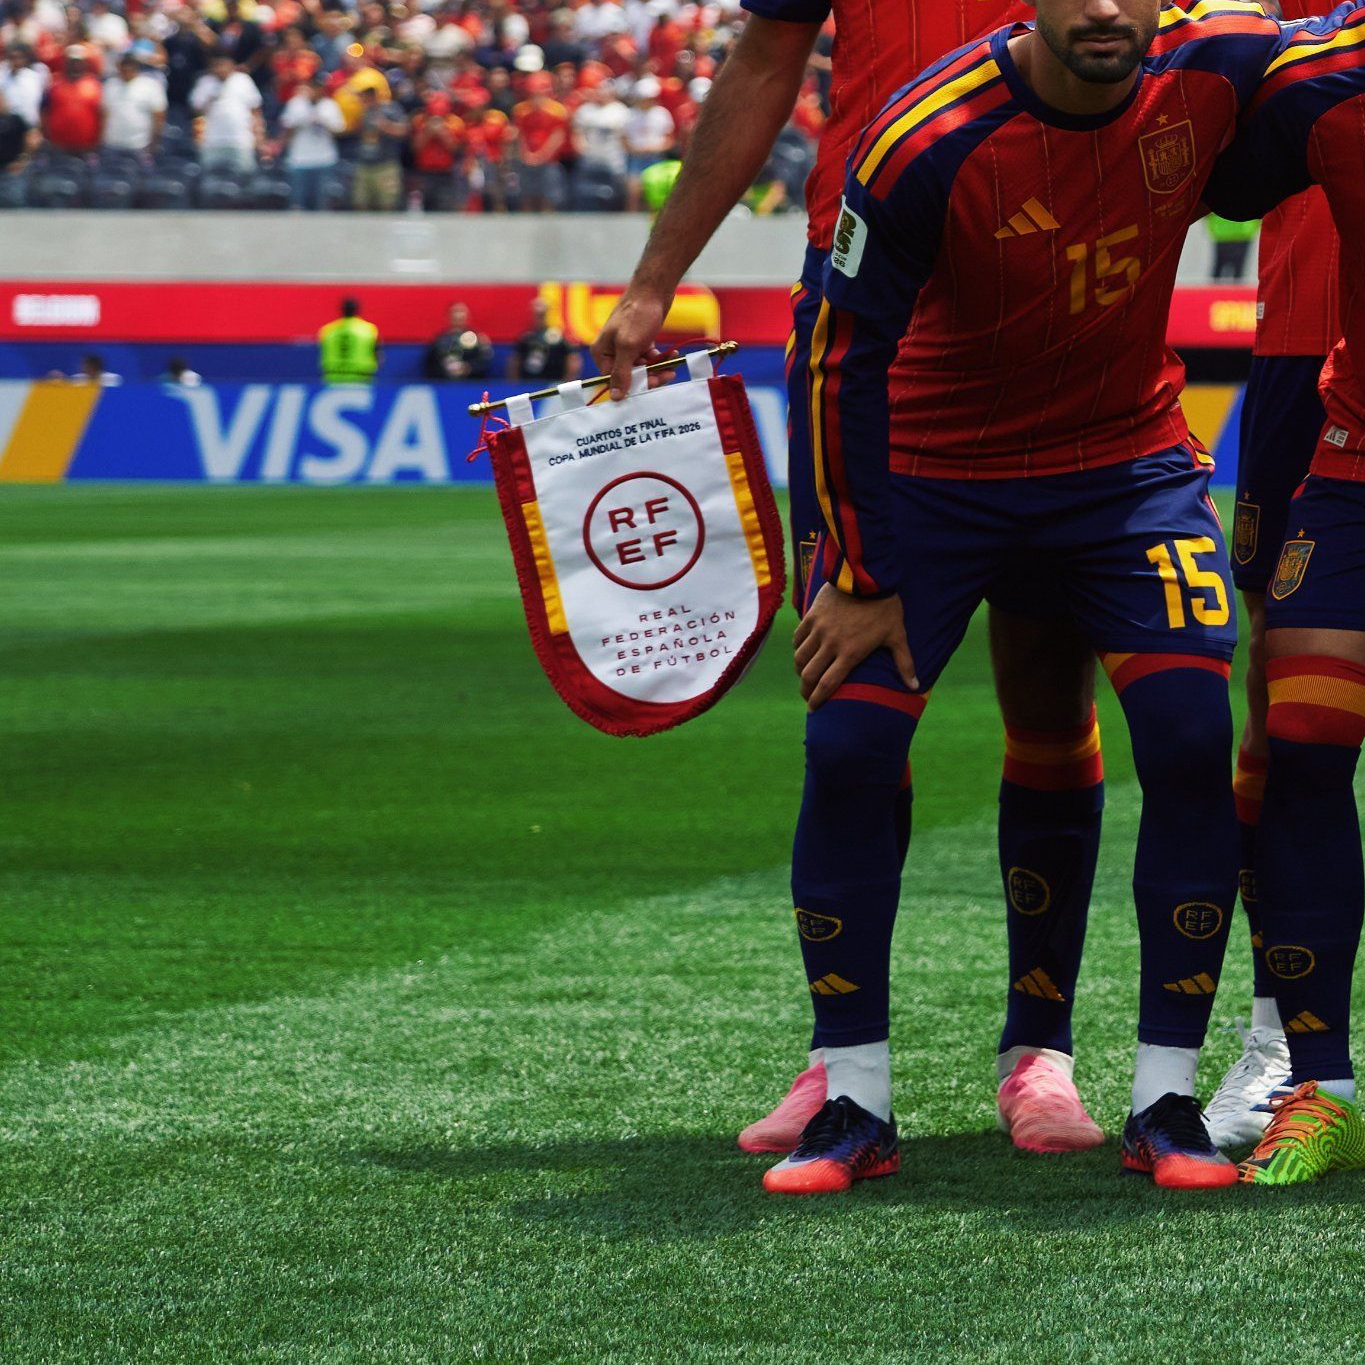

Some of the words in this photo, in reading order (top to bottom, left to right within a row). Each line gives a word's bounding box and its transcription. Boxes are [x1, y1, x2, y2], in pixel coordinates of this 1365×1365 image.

[1066, 224, 1141, 315] 15
[166, 384, 450, 483] VISA
[549, 453, 575, 466] COPA
[579, 440, 622, 459] MUNDIAL
[624, 437, 637, 447] DE
[639, 433, 652, 444] LA
[655, 428, 675, 440] FIFA
[679, 422, 701, 434] 2026
[577, 428, 622, 447] CUARTOS
[625, 425, 638, 435] DE
[640, 418, 667, 432] FINAL
[1146, 537, 1230, 629] 15
[601, 611, 735, 647] FEDERACIÓN
[639, 605, 691, 622] REAL
[616, 664, 641, 677] DE
[654, 645, 732, 670] FÚTBOL
[617, 630, 727, 660] ESPAÑOLA
